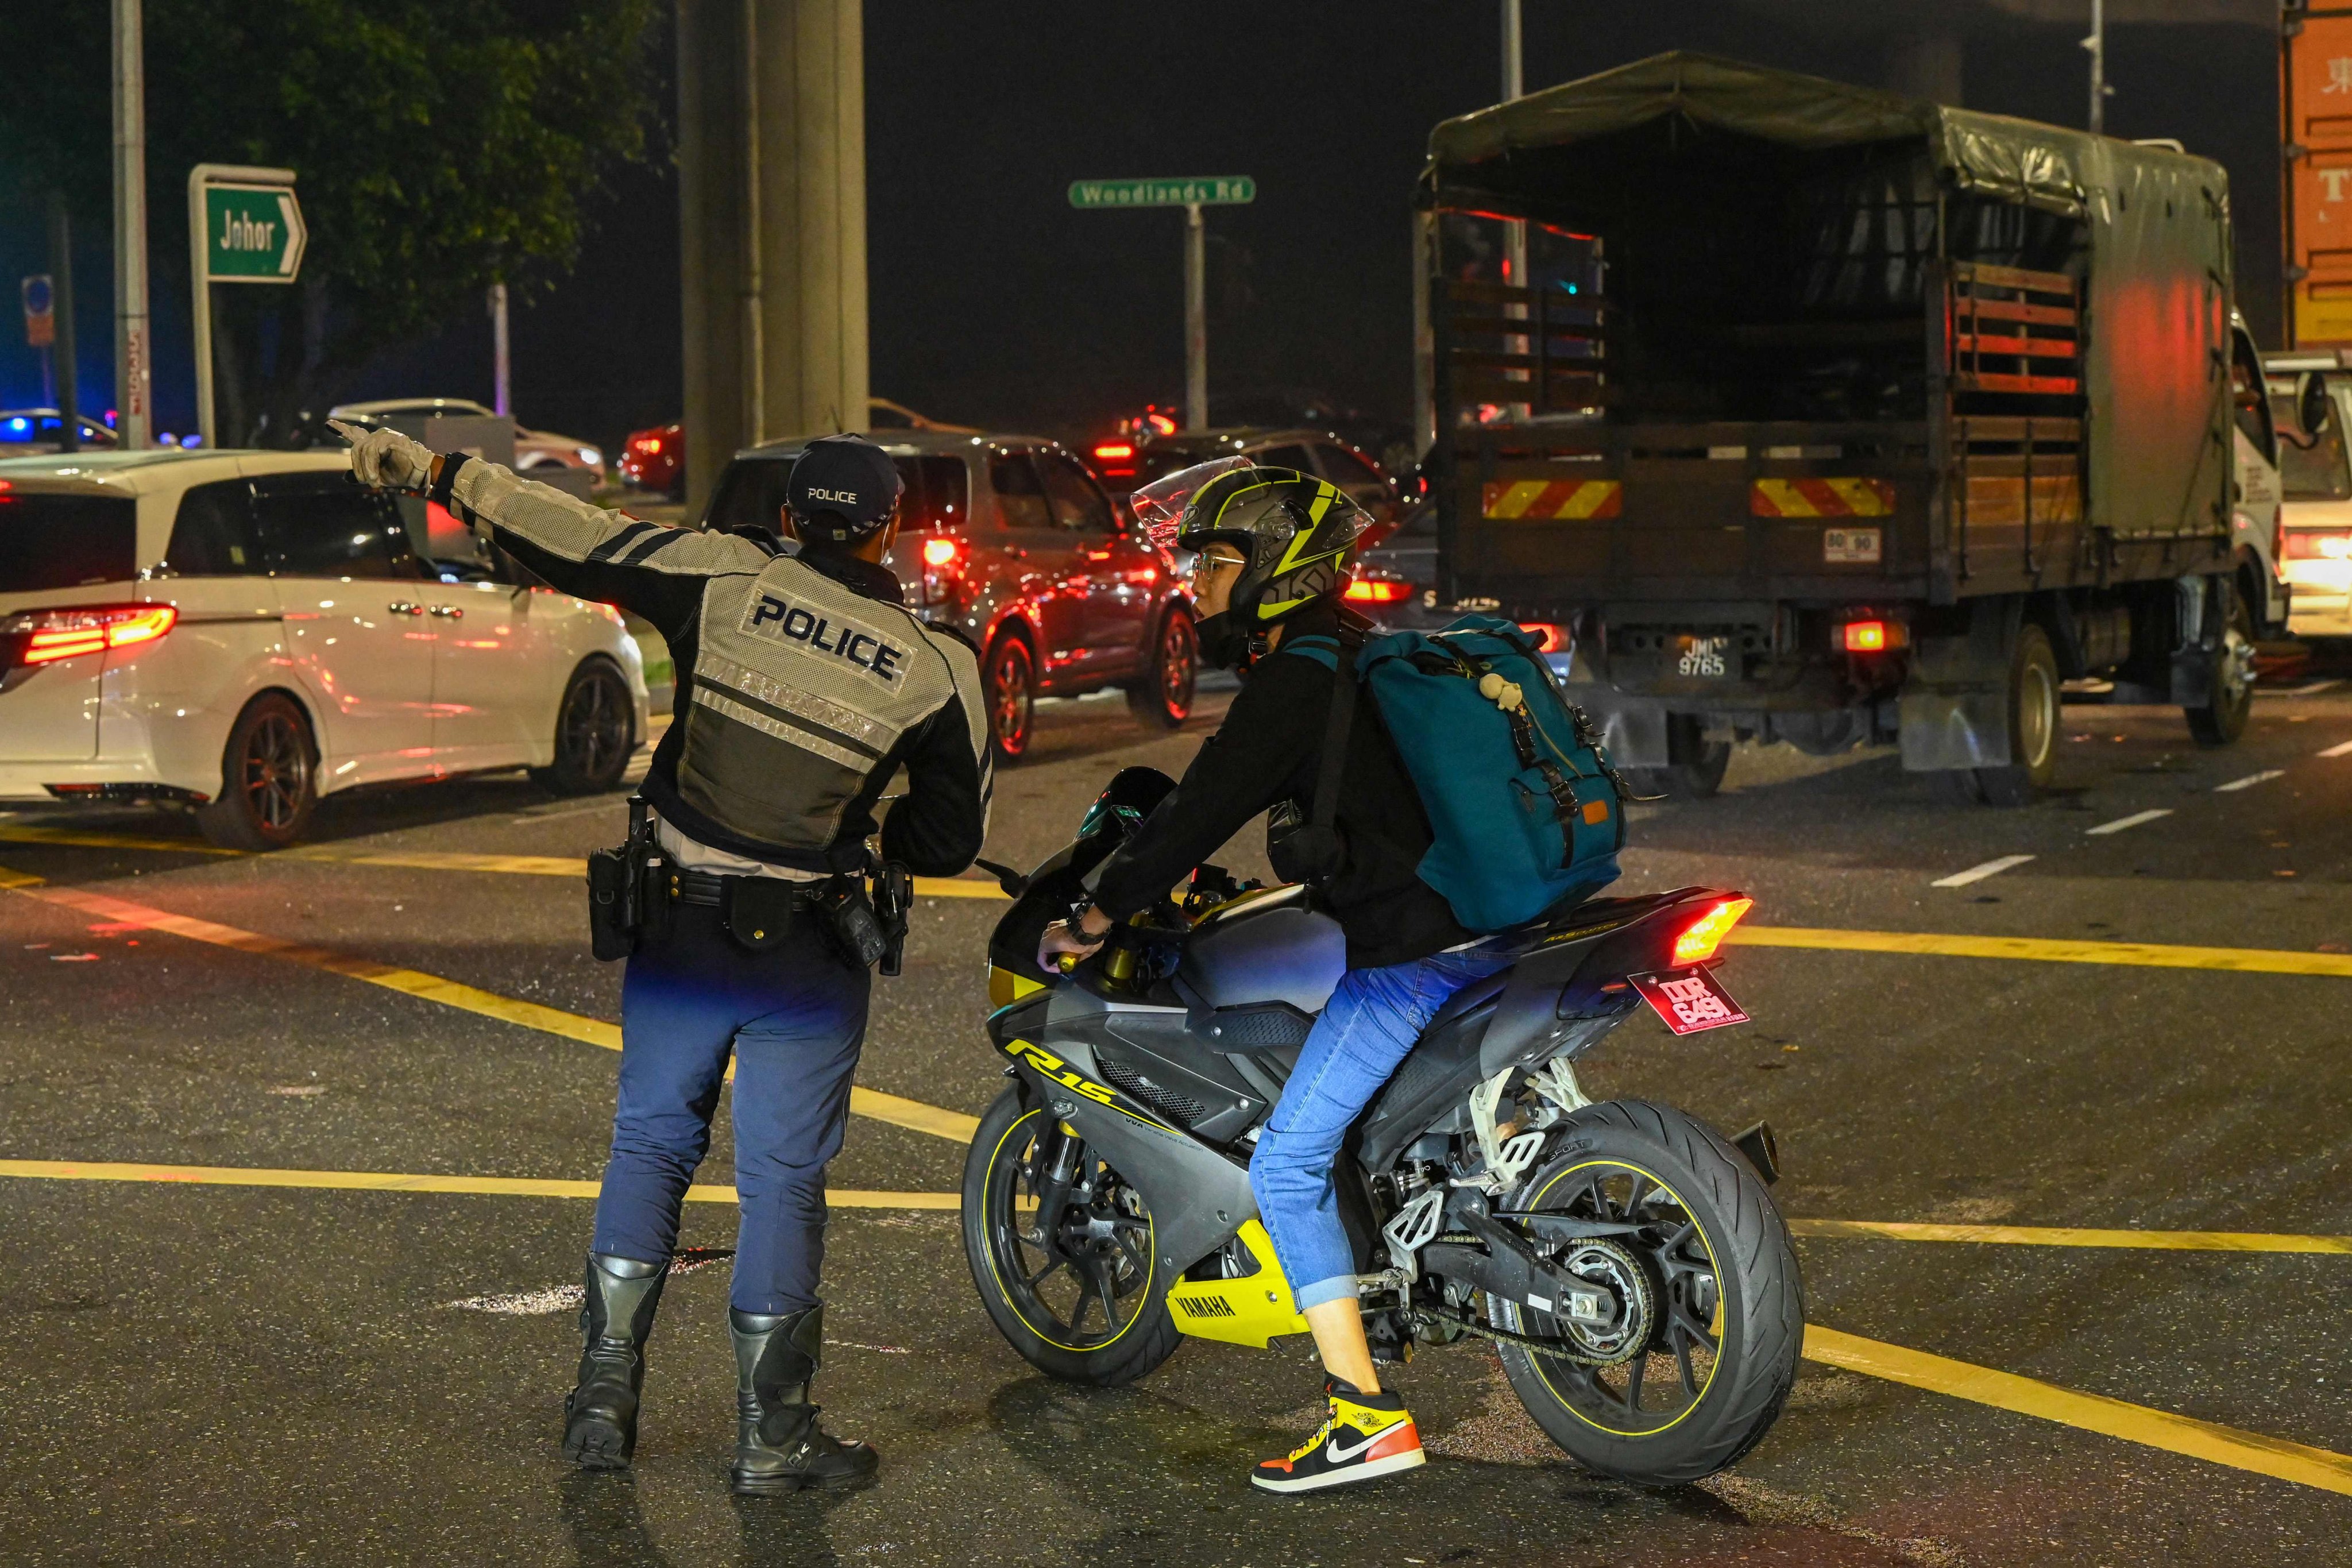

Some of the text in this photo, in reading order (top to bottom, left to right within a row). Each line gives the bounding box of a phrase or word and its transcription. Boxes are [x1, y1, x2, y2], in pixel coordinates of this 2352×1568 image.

[1082, 181, 1243, 202] Woodlands Rd
[2318, 168, 2352, 202] T
[220, 209, 276, 251] Johor
[808, 488, 857, 505] POLICE
[752, 594, 902, 682] POLICE
[1678, 656, 1725, 677] 9765
[1658, 976, 1713, 1004] DDR
[1672, 995, 1732, 1024] 6491
[1005, 1038, 1117, 1104] R15
[1125, 1117, 1143, 1129] VVA
[1178, 1140, 1204, 1152] Actuation
[1549, 1140, 1585, 1161] SPORT
[1175, 1295, 1236, 1318] YAMAHA
